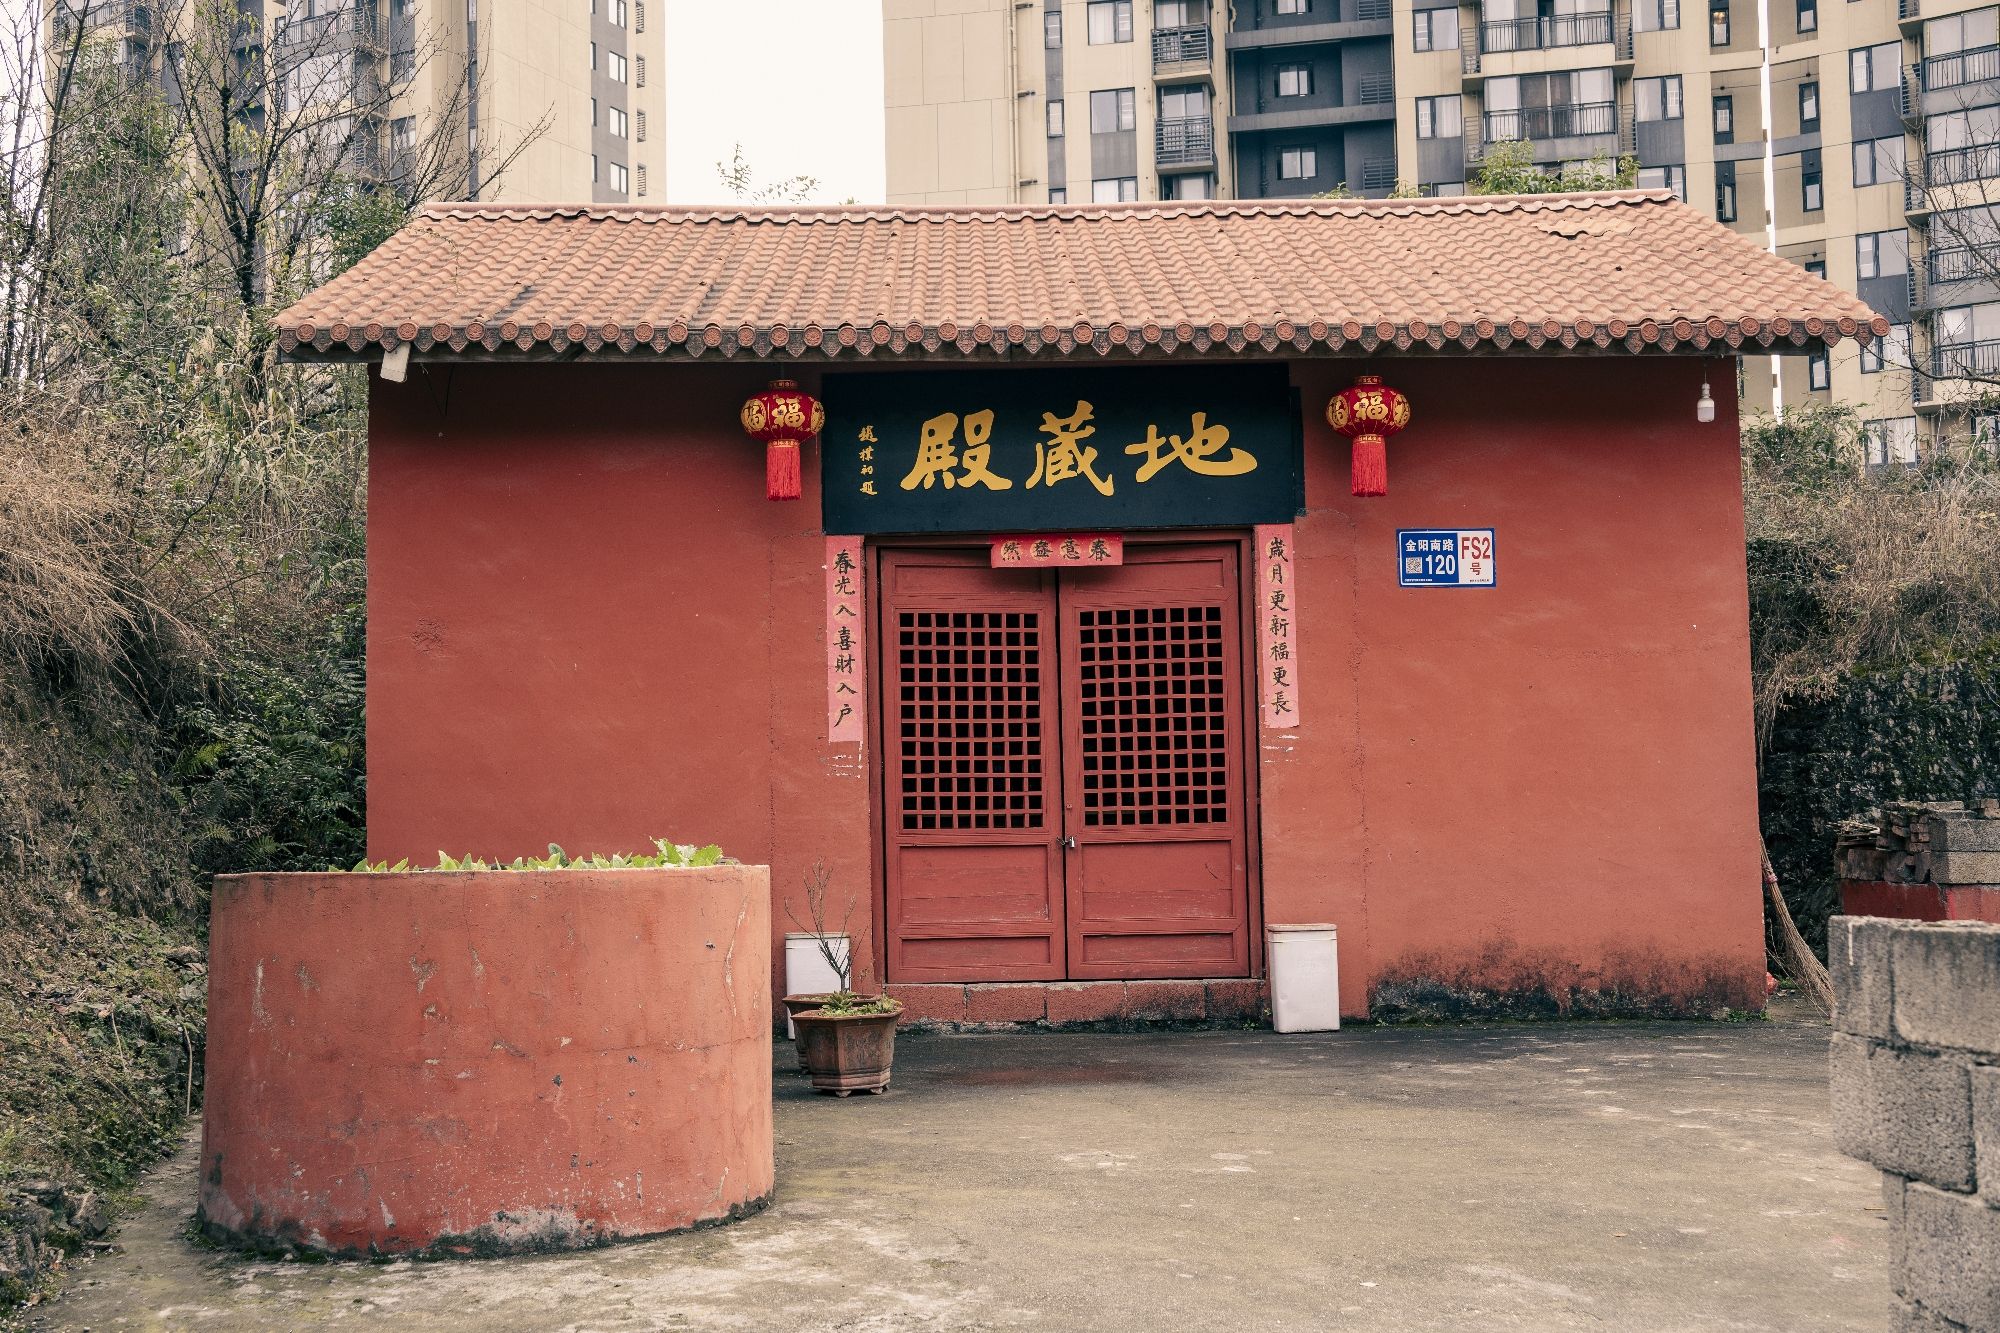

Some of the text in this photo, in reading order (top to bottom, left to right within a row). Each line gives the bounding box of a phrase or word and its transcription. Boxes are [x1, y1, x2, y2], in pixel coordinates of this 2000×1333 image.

[772, 398, 806, 428] 福
[1354, 391, 1389, 420] 福
[1405, 539, 1454, 552] 金阳南路
[1461, 536, 1491, 559] FS2
[1425, 554, 1456, 575] 120
[1469, 562, 1481, 576] 号
